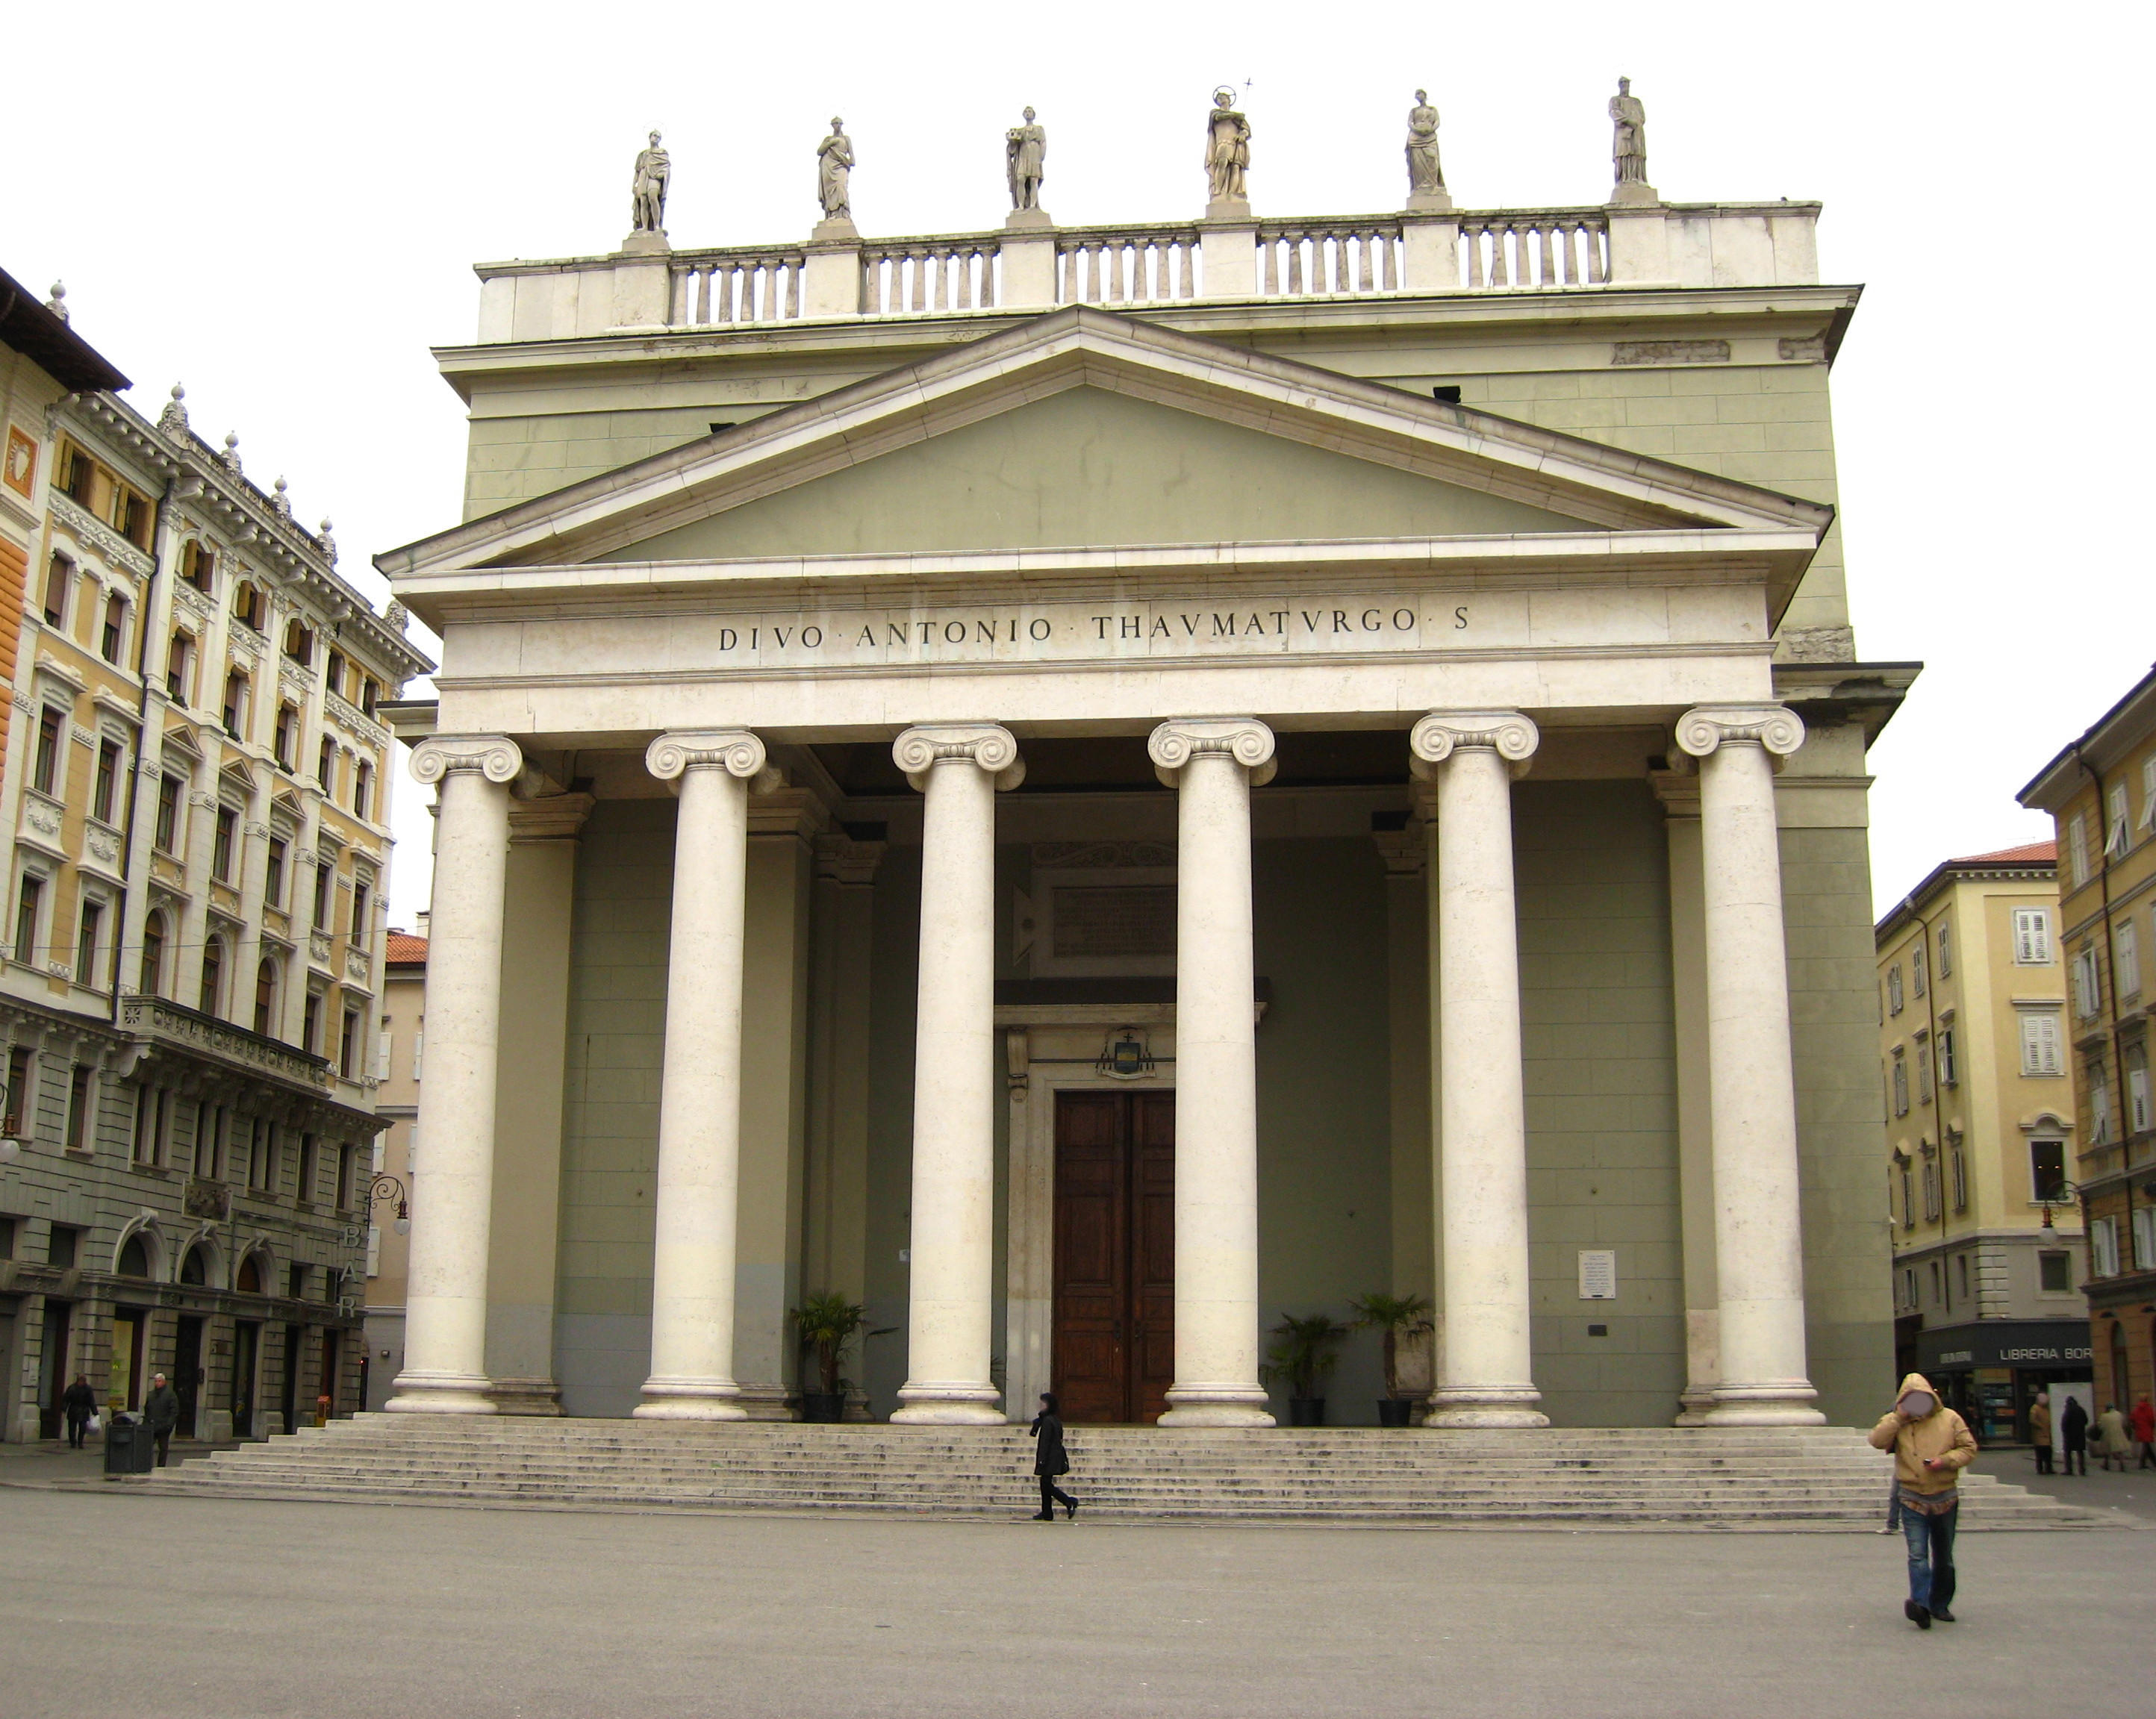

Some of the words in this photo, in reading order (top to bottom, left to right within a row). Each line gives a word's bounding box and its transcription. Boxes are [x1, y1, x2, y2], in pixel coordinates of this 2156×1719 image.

[720, 626, 823, 651] DIVO
[856, 618, 1052, 648] ANTONIO
[1091, 608, 1416, 640] THAVMATVRGO
[338, 1224, 362, 1318] BAR
[1999, 1348, 2058, 1360] LIBRERIA
